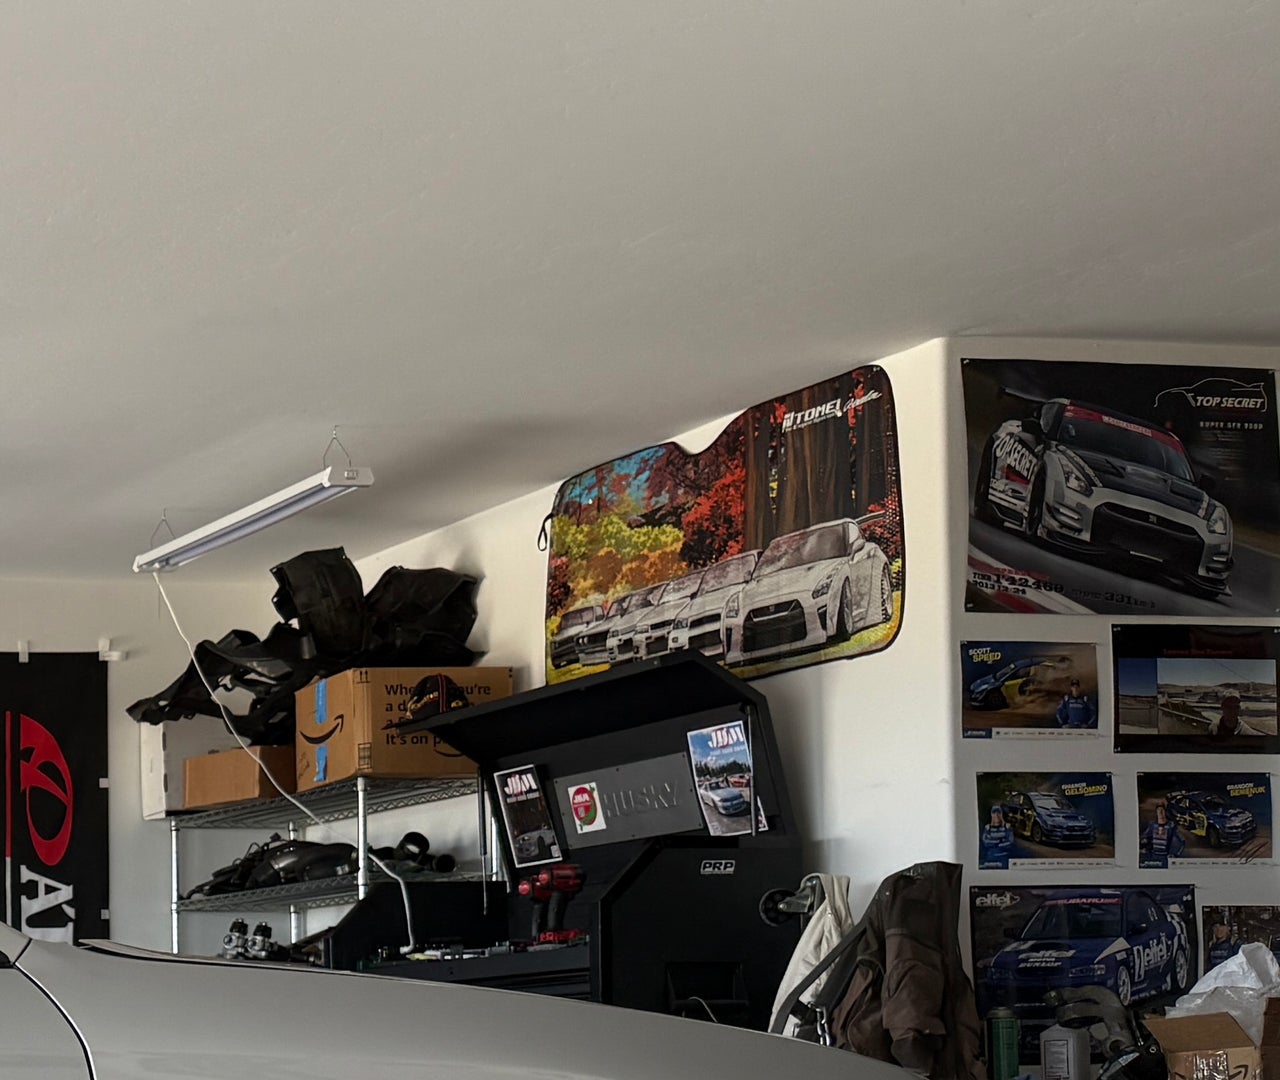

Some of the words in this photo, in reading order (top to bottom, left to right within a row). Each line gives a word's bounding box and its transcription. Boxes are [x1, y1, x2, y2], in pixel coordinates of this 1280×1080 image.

[1196, 396, 1220, 407] TOP
[1220, 397, 1264, 408] SECRET
[968, 647, 991, 656] SCOTT
[973, 652, 1001, 663] SPEED
[411, 735, 428, 745] on
[603, 781, 678, 818] HUSKY
[702, 860, 735, 873] PRP
